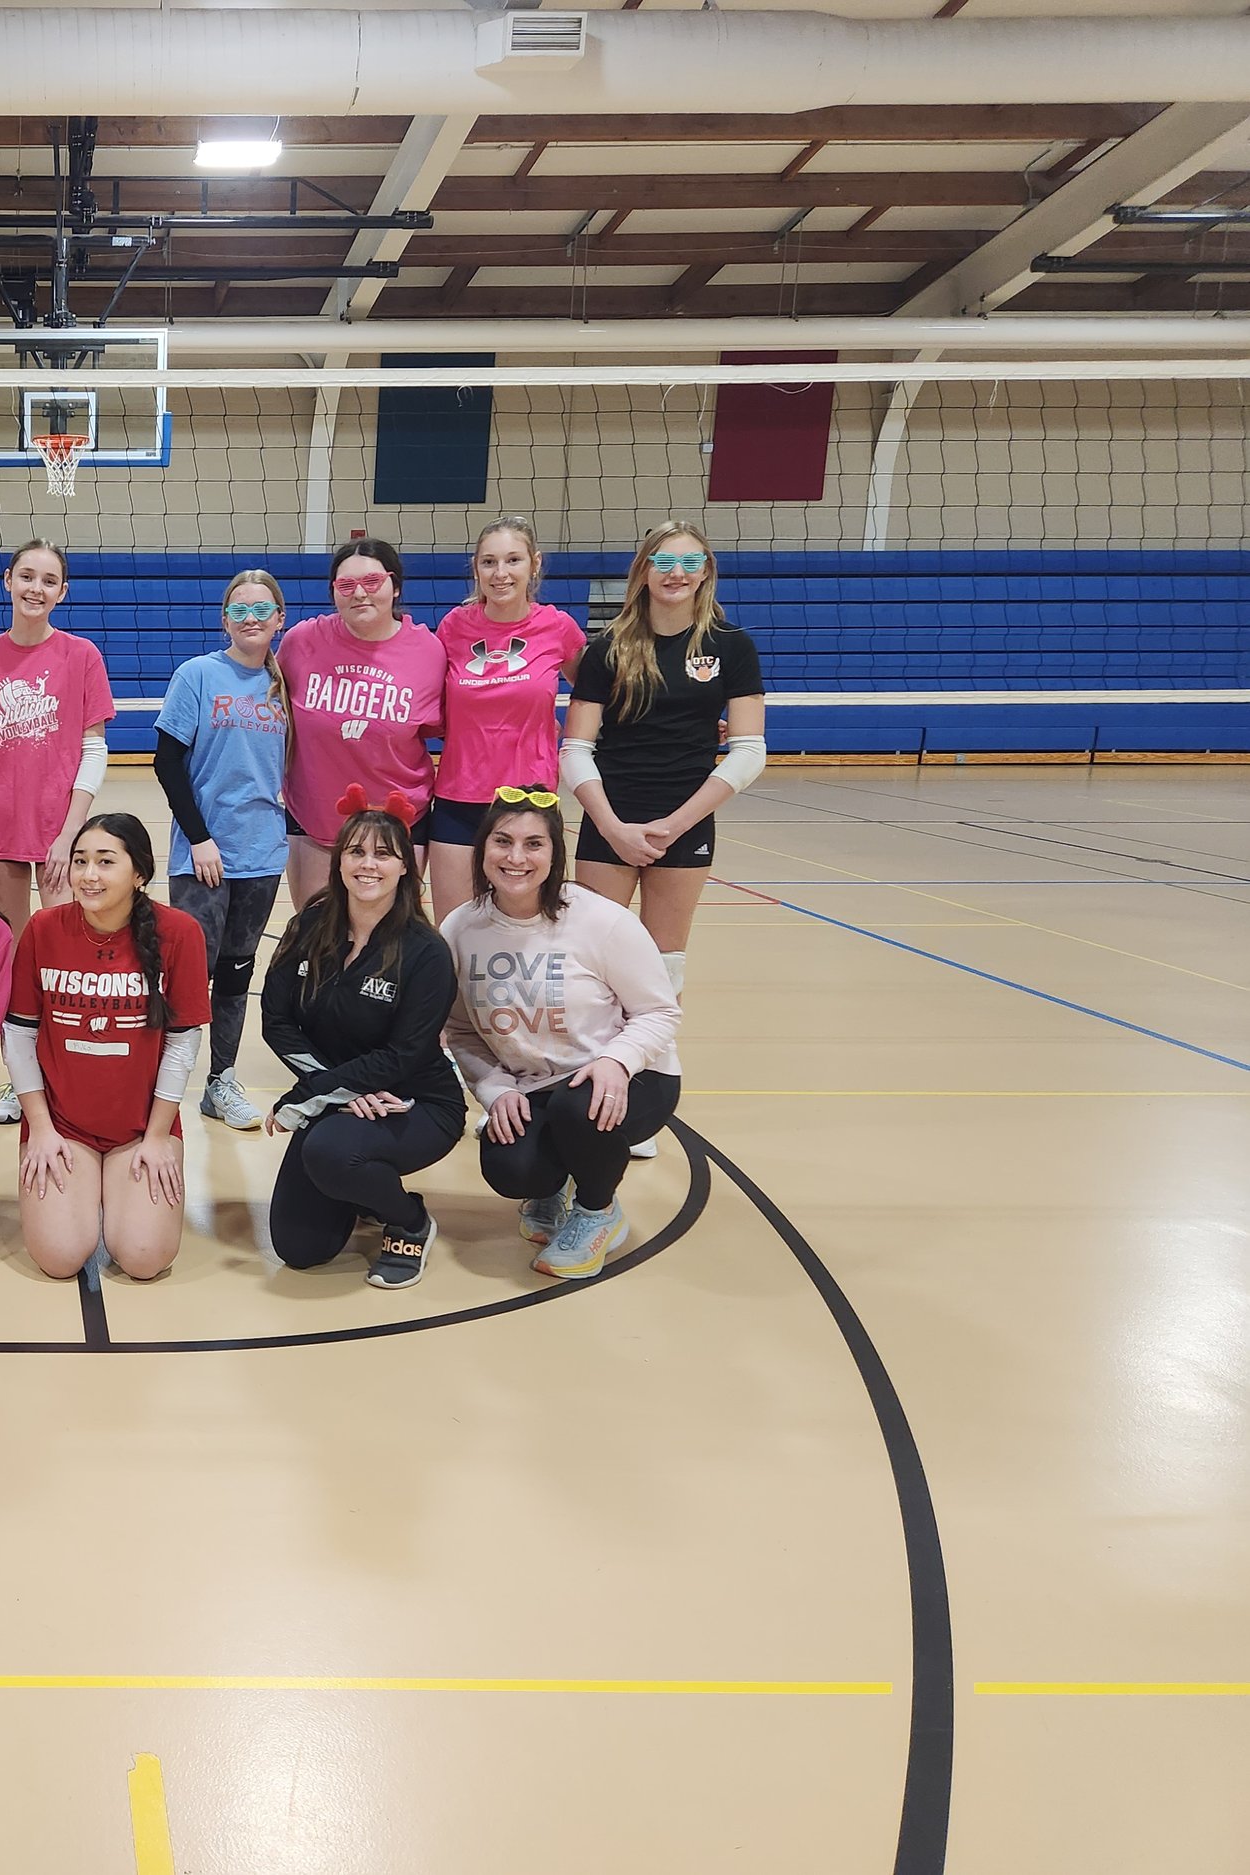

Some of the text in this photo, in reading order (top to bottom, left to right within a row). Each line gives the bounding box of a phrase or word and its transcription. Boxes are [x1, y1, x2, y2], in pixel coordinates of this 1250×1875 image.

[334, 665, 394, 683] WISCONSIN
[459, 673, 530, 686] UNDER ARMOUR
[305, 673, 413, 723] BADGERS
[211, 719, 285, 736] VOLLEYBAL
[341, 719, 369, 740] W
[470, 952, 566, 981] LOVE
[361, 976, 397, 998] AVC
[470, 980, 565, 1008] LOVE
[50, 994, 142, 1010] VOLLEYBAL
[89, 1016, 108, 1032] W
[472, 1007, 568, 1036] LOVE
[382, 1236, 422, 1257] didas
